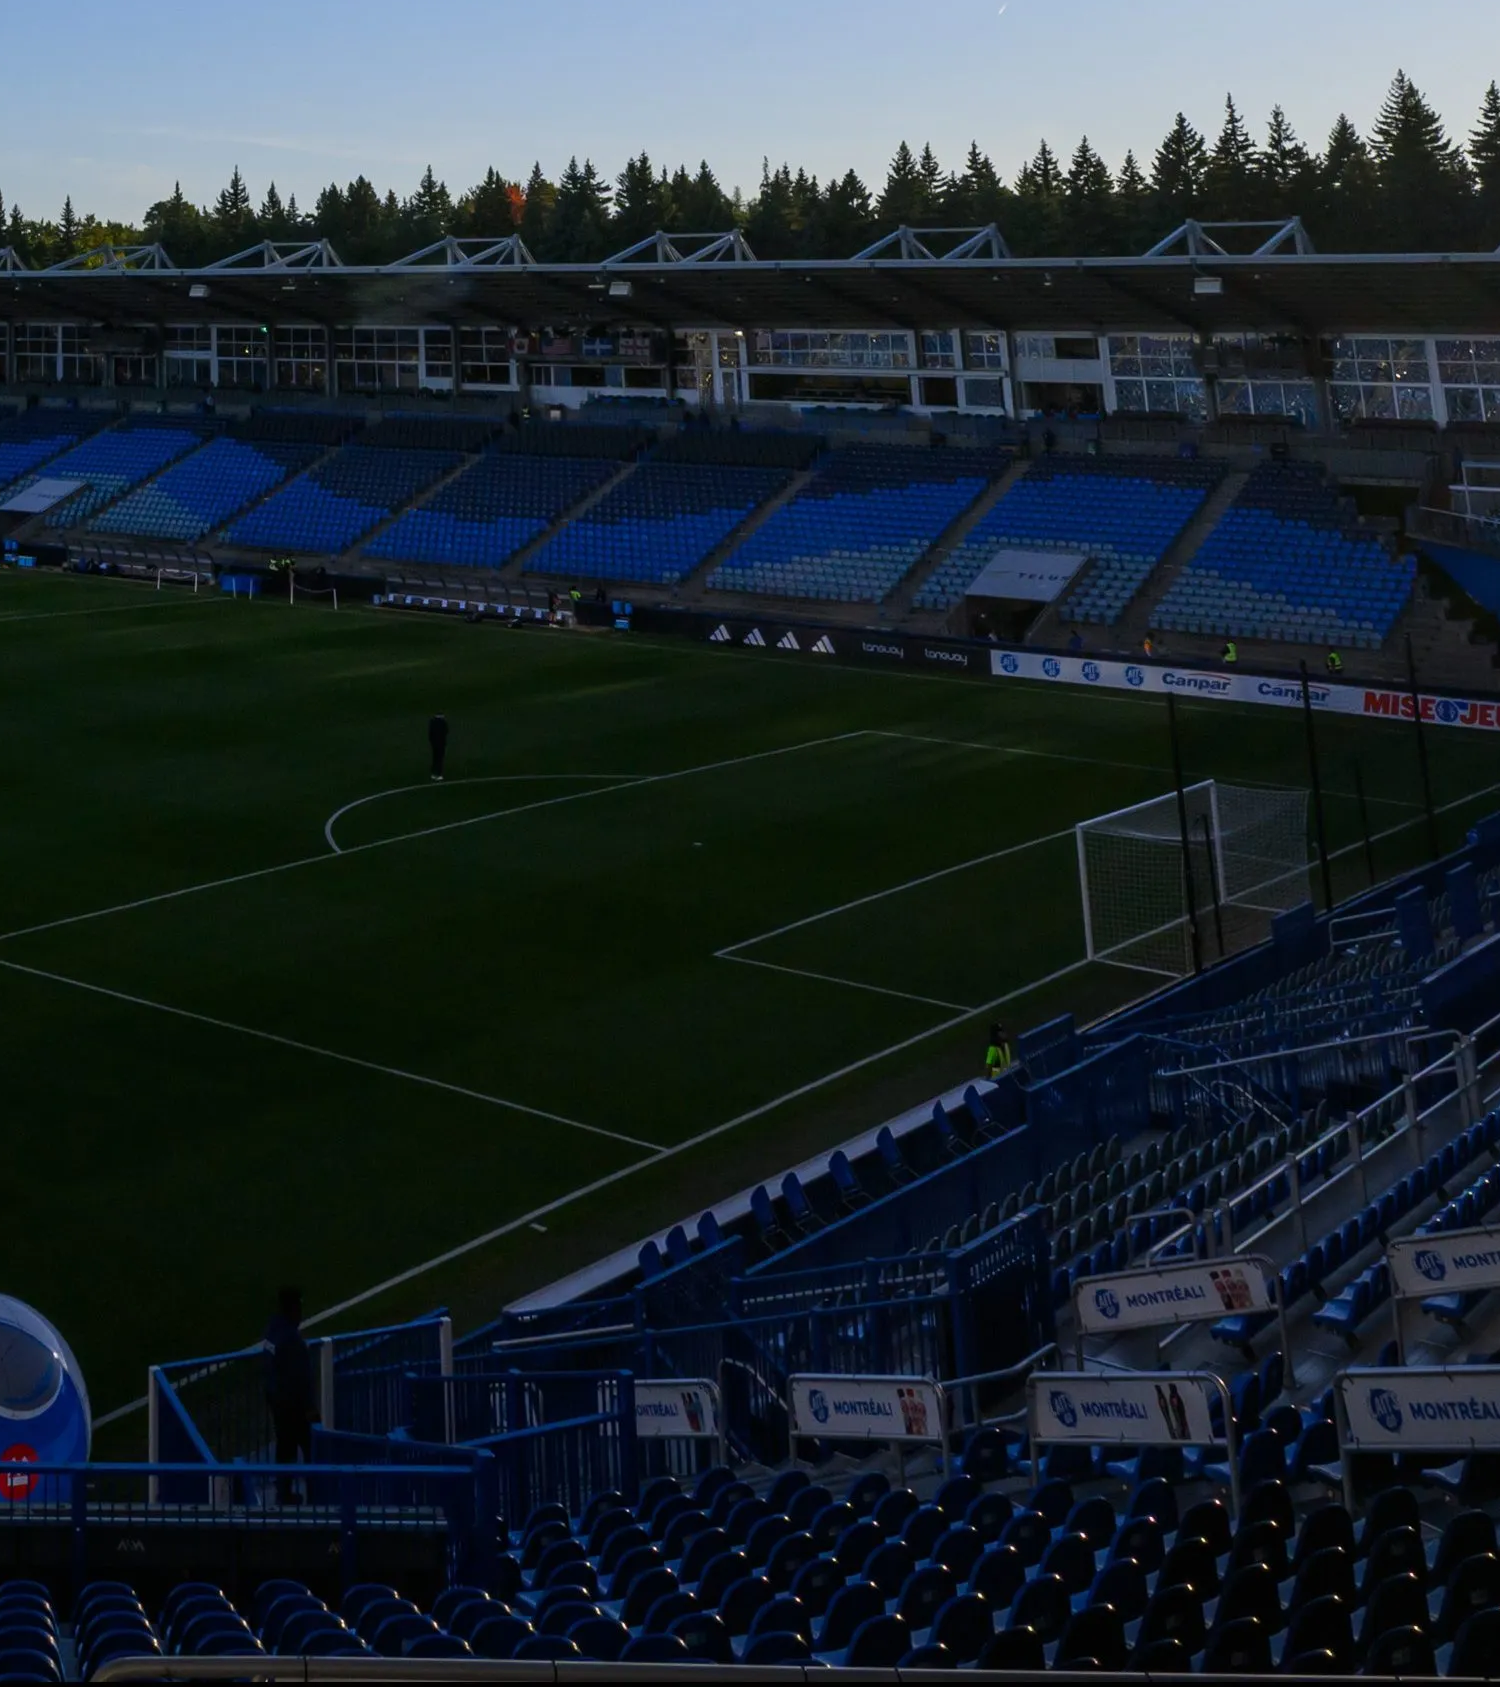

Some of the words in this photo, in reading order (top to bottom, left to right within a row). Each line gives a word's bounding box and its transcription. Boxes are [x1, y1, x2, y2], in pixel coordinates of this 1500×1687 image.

[862, 641, 904, 659] tanguay
[925, 647, 969, 666] tanguay
[1162, 672, 1231, 692] Canpar
[1258, 682, 1330, 702] Canpar
[1364, 691, 1436, 721] MISE
[1126, 1285, 1207, 1308] MONTRÉAL!
[833, 1398, 893, 1417] MONTRÉAL!
[1081, 1398, 1149, 1420] MONTRÉAL!
